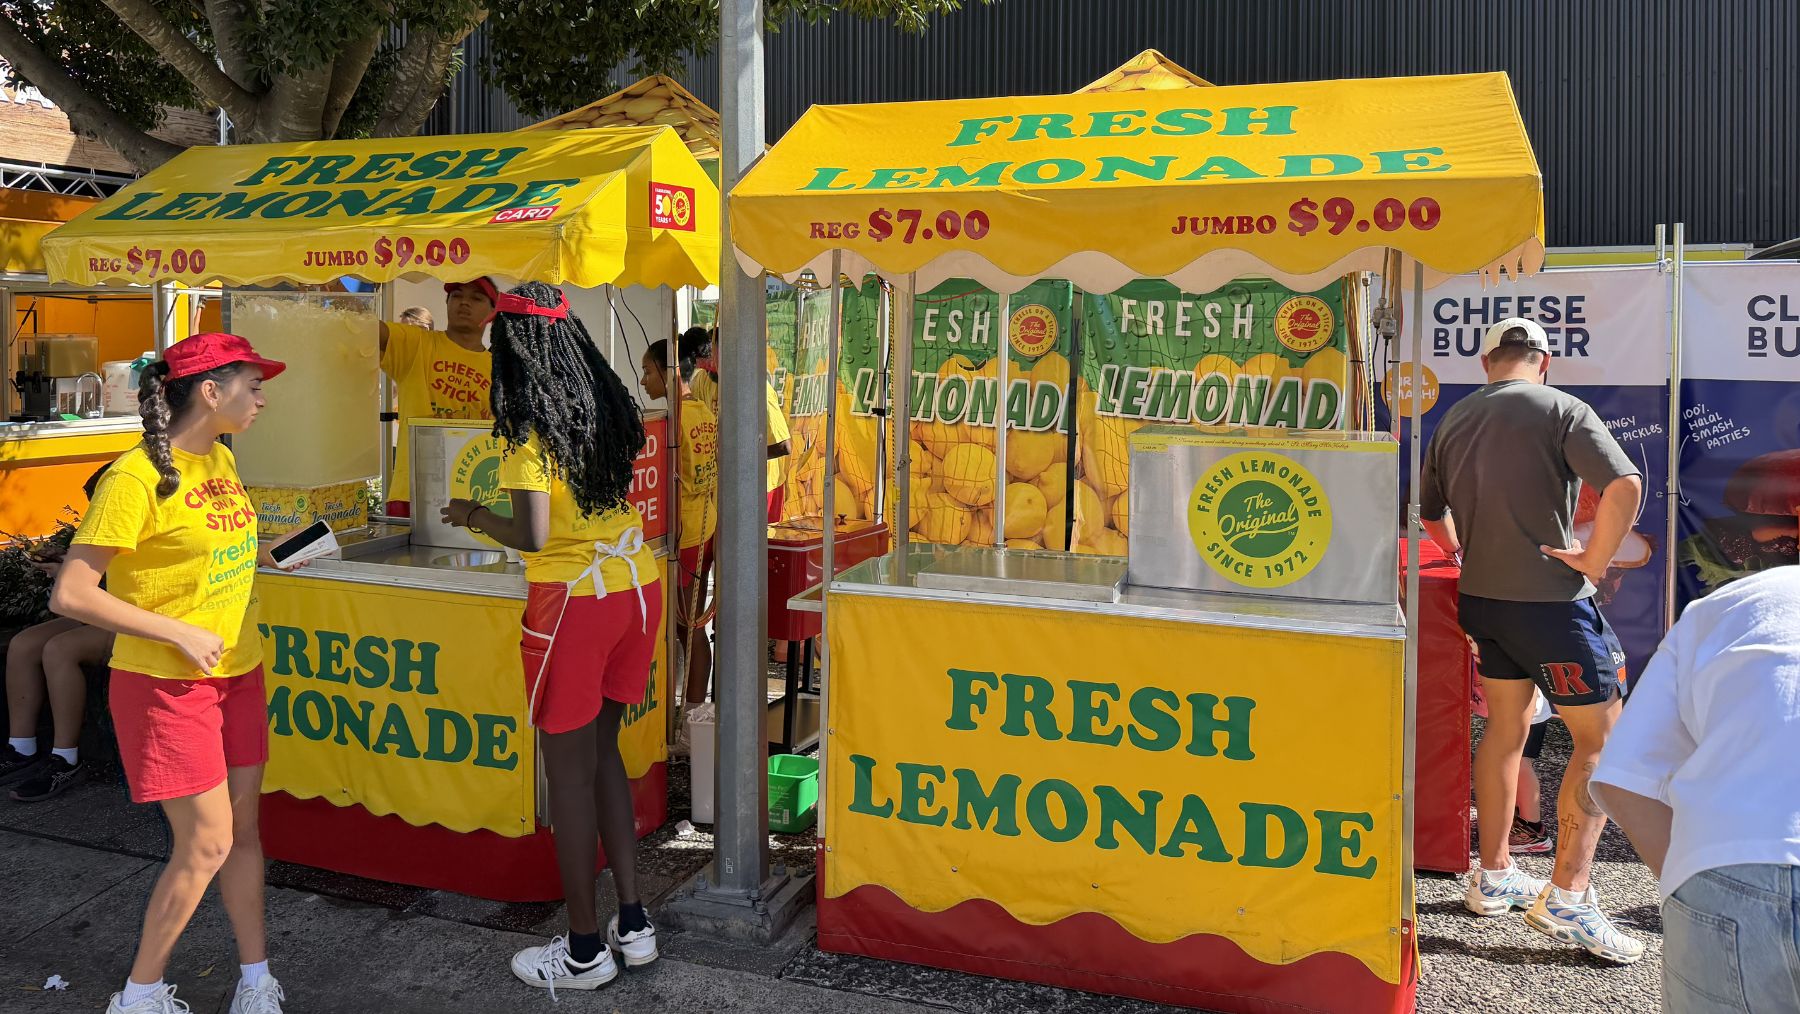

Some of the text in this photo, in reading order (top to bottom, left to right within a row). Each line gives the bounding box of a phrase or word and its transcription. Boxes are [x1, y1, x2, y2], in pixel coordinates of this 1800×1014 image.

[946, 105, 1299, 147] FRESH
[234, 147, 528, 186] FRESH
[796, 147, 1453, 191] LEMONADE
[95, 178, 580, 221] LEMONADE
[496, 207, 553, 221] CARD
[810, 207, 990, 244] REG $7.00
[1171, 197, 1441, 237] JUMBO $9.00
[88, 246, 206, 278] REG $7.00
[303, 236, 470, 268] JUMBO $9.00
[1120, 300, 1253, 339] FRESH
[1433, 295, 1586, 325] CHEESE
[1747, 294, 1800, 322] CL
[923, 308, 991, 344] ESH
[1433, 327, 1590, 357] BUER
[1748, 326, 1800, 358] BU
[431, 378, 480, 402] STICK
[433, 360, 490, 390] CHEESE
[448, 375, 462, 385] ON
[1692, 418, 1734, 442] SMASH
[1706, 426, 1751, 450] PATTIES
[456, 445, 480, 484] FRESH
[184, 477, 247, 509] CHEESE
[212, 497, 238, 511] ON A
[1197, 460, 1322, 518] FRESH LEMONADE
[1244, 493, 1273, 512] The
[206, 502, 256, 532] STICK
[262, 502, 281, 513] Fresh
[324, 501, 343, 511] Fresh
[1218, 503, 1297, 539] Original
[1207, 543, 1308, 578] SINCE 1972
[257, 623, 440, 695] RESH
[1543, 662, 1594, 696] R
[944, 668, 1257, 762] FRESH
[847, 753, 1379, 881] LEMONADE
